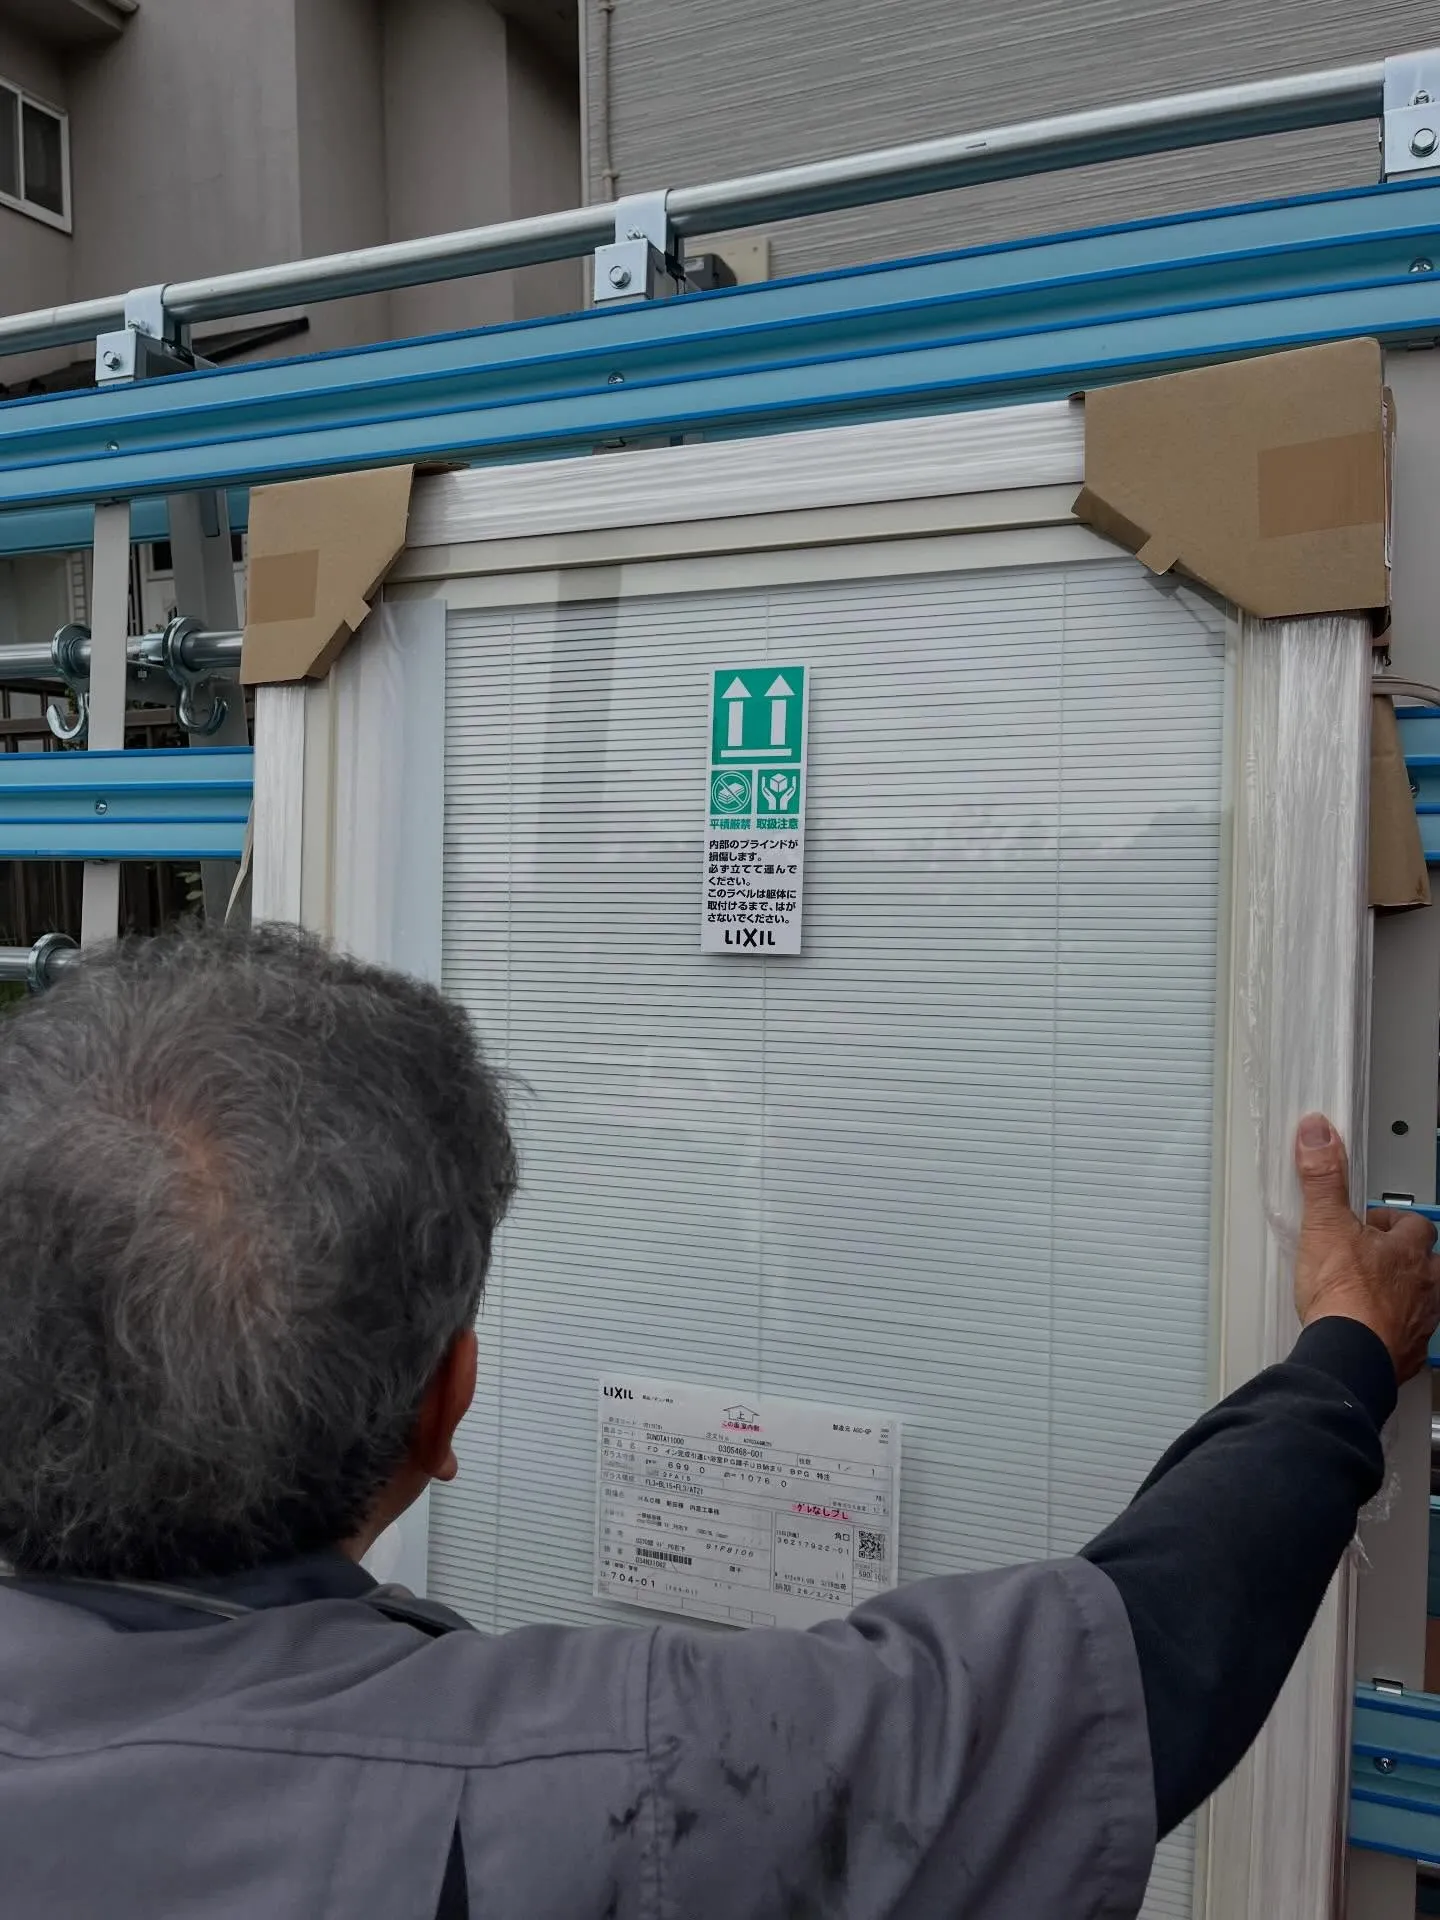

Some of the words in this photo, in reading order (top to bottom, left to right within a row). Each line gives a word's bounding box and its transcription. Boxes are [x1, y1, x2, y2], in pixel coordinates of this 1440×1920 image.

[710, 819, 750, 830] 平積厳禁
[756, 818, 798, 830] 取扱注意
[709, 840, 798, 849] 内部のブラインドが
[709, 852, 762, 861] 損傷します。
[709, 864, 797, 874] 必ず立てて運んで
[709, 877, 750, 886] ください。
[708, 889, 796, 899] このラベルは躯体に
[707, 901, 796, 911] 取付けるまで、はが
[708, 913, 790, 924] さないでください。
[725, 928, 776, 947] LIXIL
[603, 1386, 634, 1400] LIXIL
